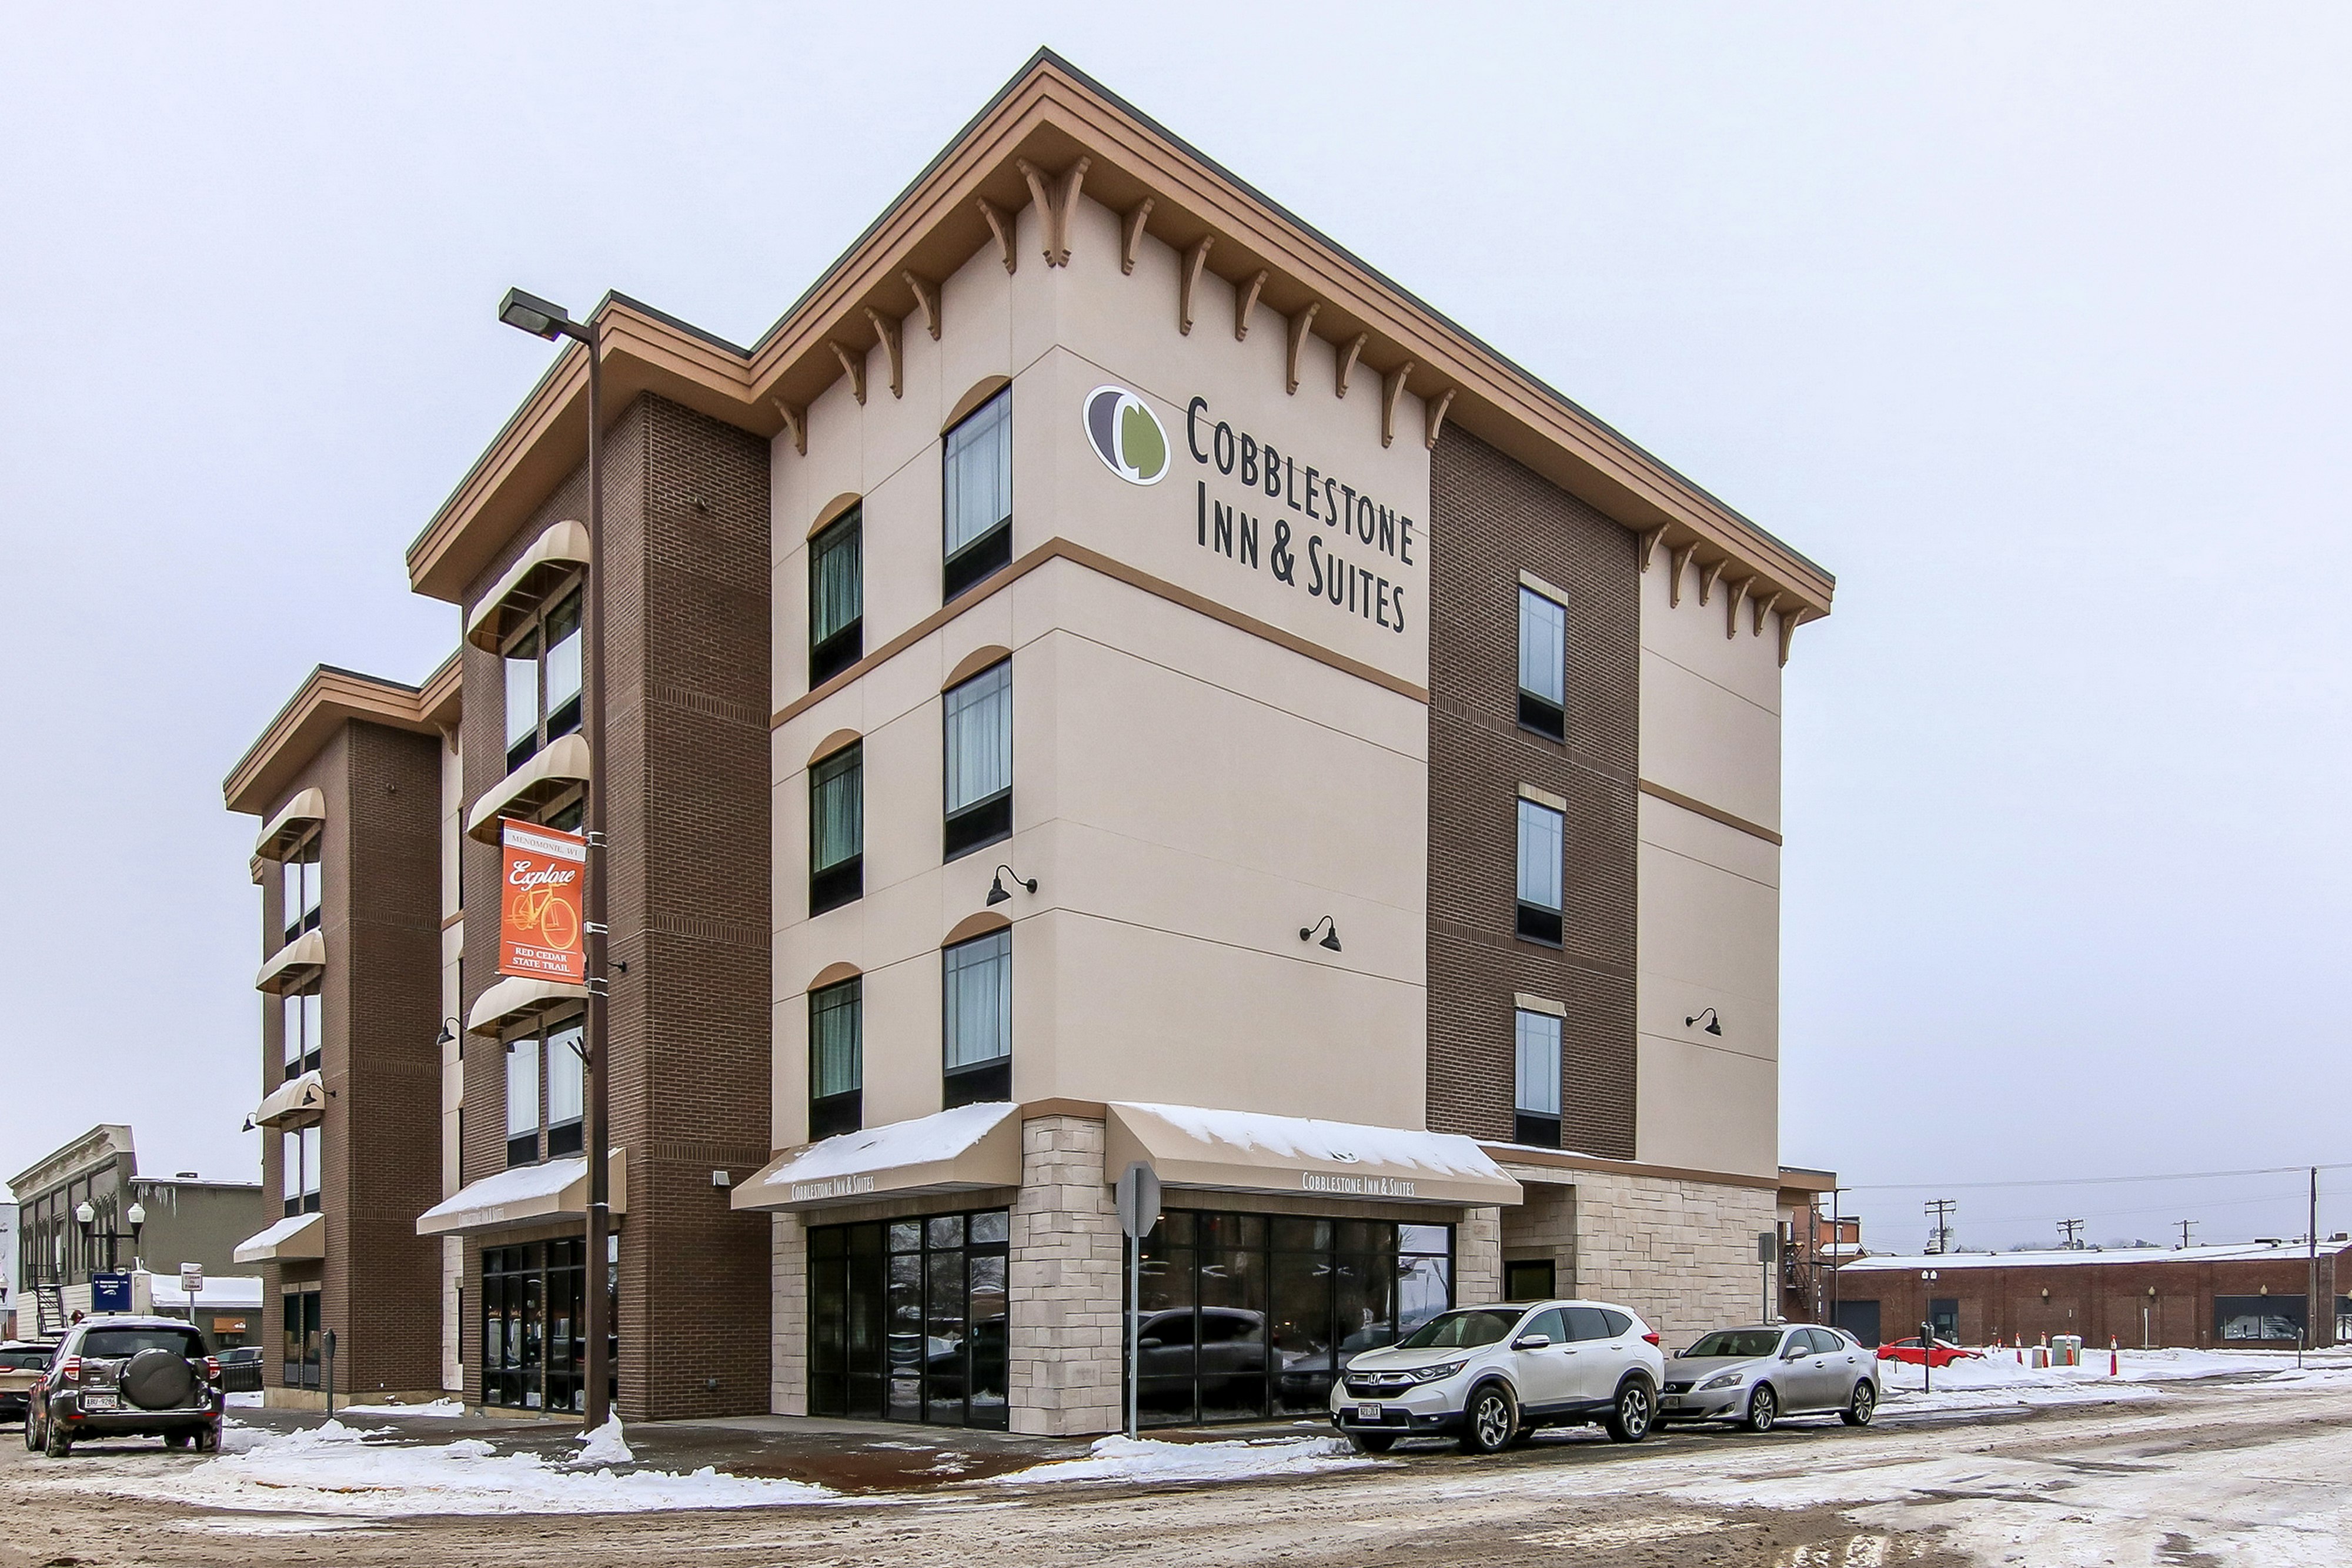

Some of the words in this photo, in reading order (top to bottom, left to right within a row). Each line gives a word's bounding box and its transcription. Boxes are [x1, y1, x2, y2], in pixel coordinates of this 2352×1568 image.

[1187, 396, 1412, 566] COBBLESTONE
[1198, 480, 1258, 569] INN
[1271, 519, 1295, 587] &
[1308, 535, 1404, 633] SUITES
[567, 848, 578, 856] WI
[509, 860, 576, 891] Explore
[512, 957, 540, 968] STATE
[542, 961, 570, 972] TRAIL
[515, 947, 534, 957] RED
[536, 951, 567, 962] CEDAR
[791, 1182, 832, 1201] COBBLESTONE
[833, 1178, 846, 1195] INN
[846, 1176, 851, 1194] &
[853, 1175, 874, 1193] SUITES
[1302, 1171, 1361, 1193] COBBLESTONE
[1364, 1176, 1379, 1194] INN
[1381, 1177, 1387, 1195] &
[1389, 1178, 1415, 1196] SUITES
